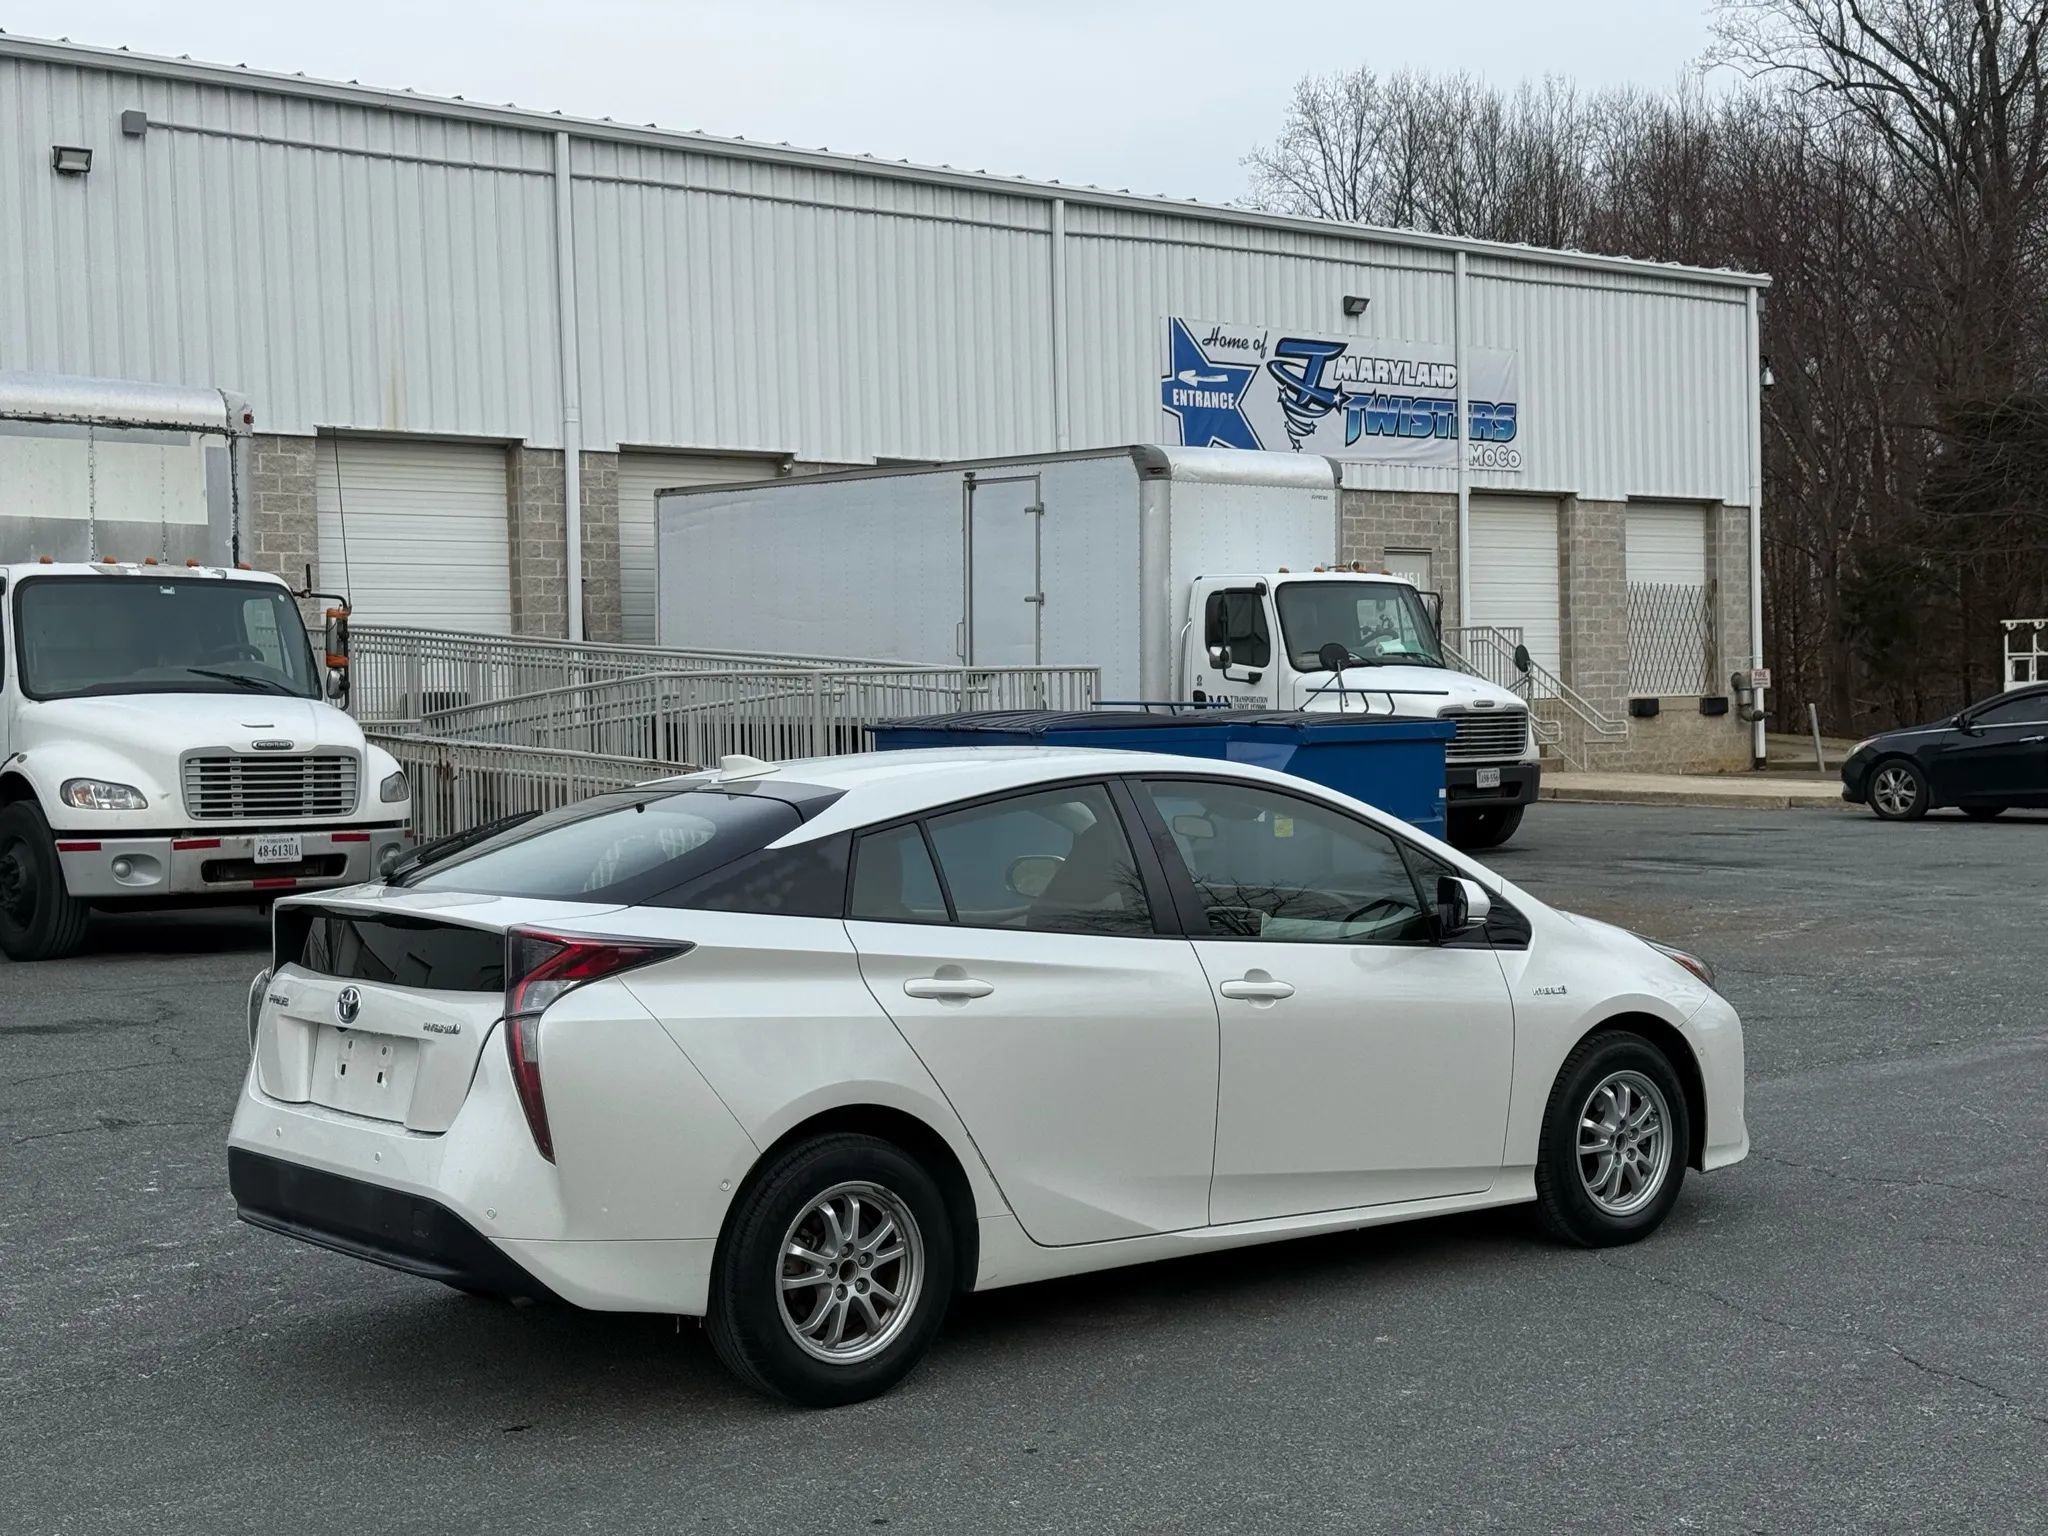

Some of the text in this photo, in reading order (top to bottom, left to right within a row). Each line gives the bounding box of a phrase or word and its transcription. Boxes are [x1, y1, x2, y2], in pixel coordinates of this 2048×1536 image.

[1202, 326, 1268, 359] Home of
[1334, 355, 1457, 389] MARYLAND
[1172, 388, 1235, 410] ENTRANCE
[1468, 444, 1521, 469] MoCo
